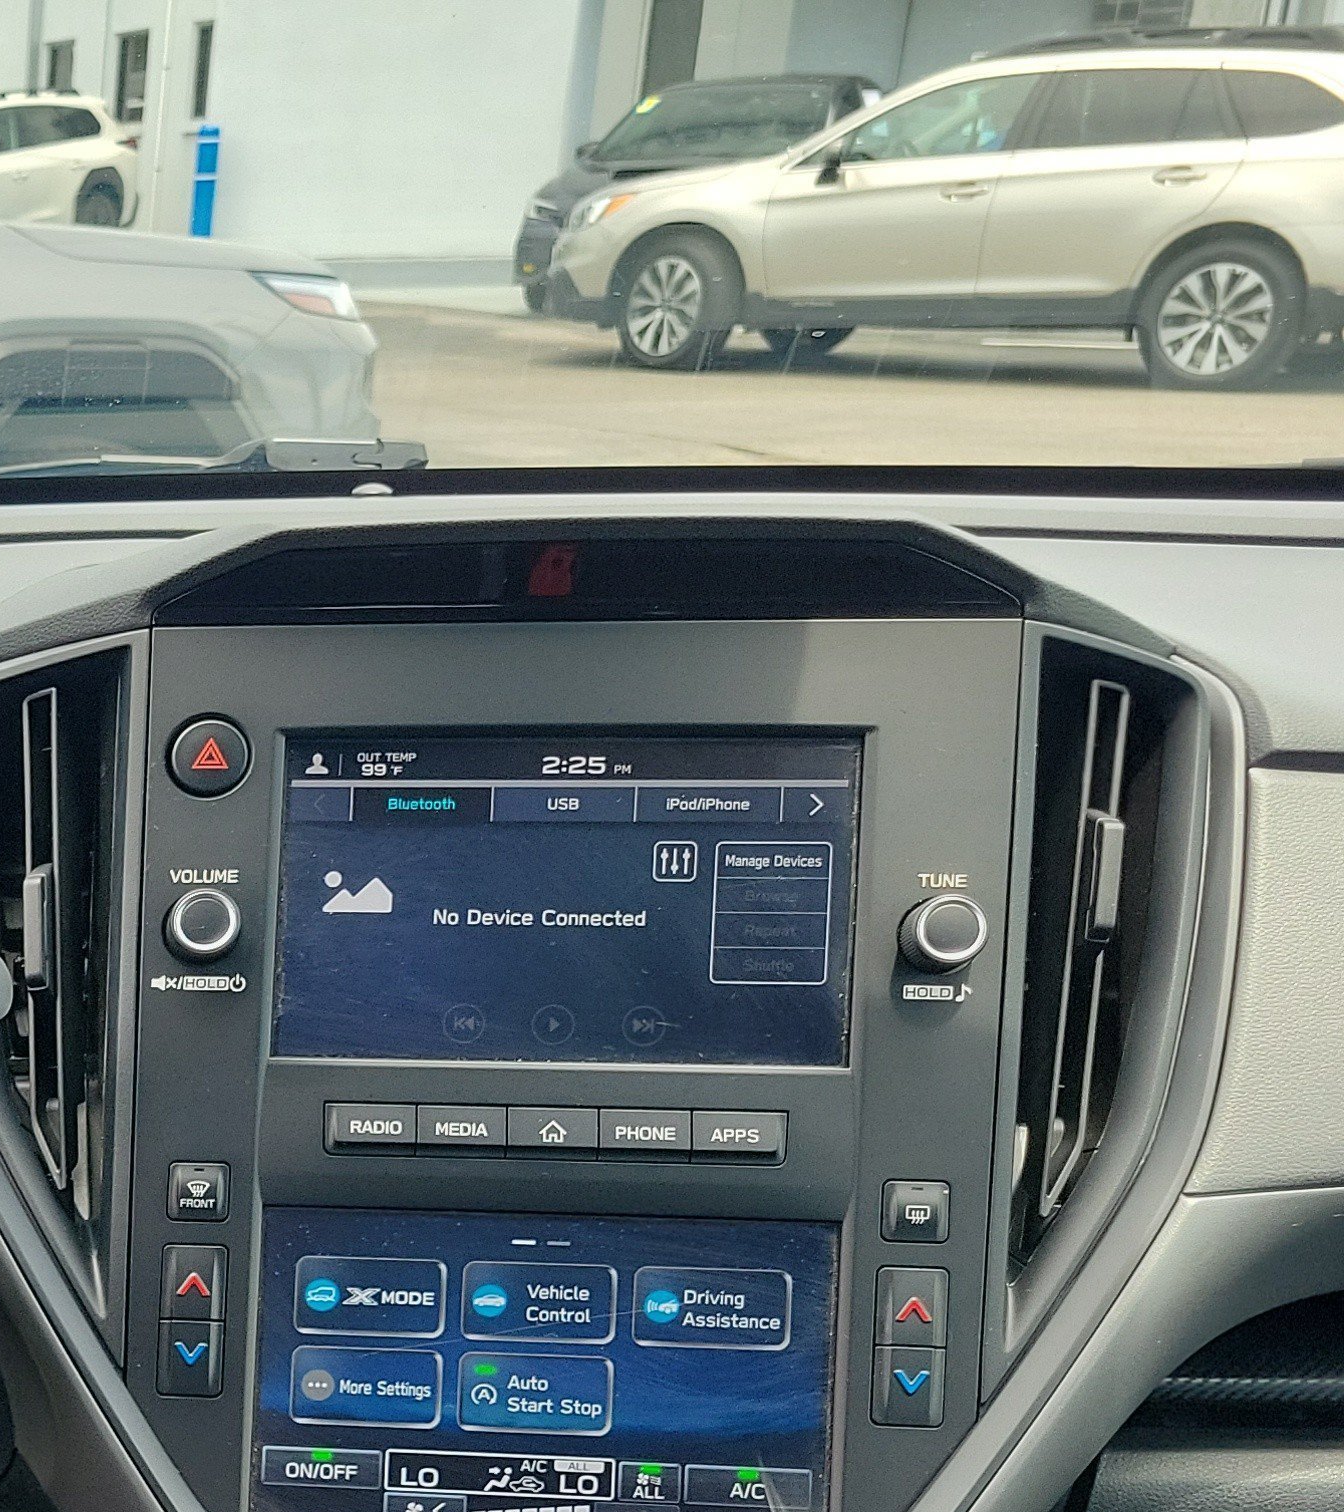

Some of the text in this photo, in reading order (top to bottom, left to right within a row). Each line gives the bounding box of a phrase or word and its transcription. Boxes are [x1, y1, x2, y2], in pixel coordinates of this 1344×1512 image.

[356, 752, 417, 763] OUT TEMP
[542, 756, 632, 775] 2:25 PM
[361, 763, 387, 776] 99
[388, 797, 456, 811] Bluetooth
[547, 798, 580, 811] USB
[666, 797, 750, 811] iPod/iPhone
[725, 854, 823, 870] Manage Devices
[169, 869, 240, 884] VOLUME
[917, 873, 969, 888] TUNE
[432, 908, 647, 928] No Device Connected
[185, 977, 229, 990] HOLD
[904, 986, 952, 999] HOLD
[350, 1120, 403, 1136] RADIO
[435, 1122, 488, 1138] MEDIA
[614, 1125, 677, 1142] PHONE
[711, 1128, 760, 1144] APPS
[179, 1198, 216, 1209] FRONT
[526, 1284, 591, 1301] Vehicle
[682, 1289, 745, 1309] Driving
[525, 1307, 591, 1323] Control
[682, 1312, 781, 1331] Assistance
[339, 1379, 431, 1400] More Settings
[507, 1375, 549, 1392] Auto
[507, 1397, 602, 1418] Start Stop
[285, 1462, 359, 1481] ON/OFF
[520, 1459, 591, 1473] A/C ALL
[400, 1467, 440, 1488] LO
[559, 1474, 599, 1495] LO
[632, 1486, 665, 1500] ALL
[730, 1482, 765, 1499] A/C
